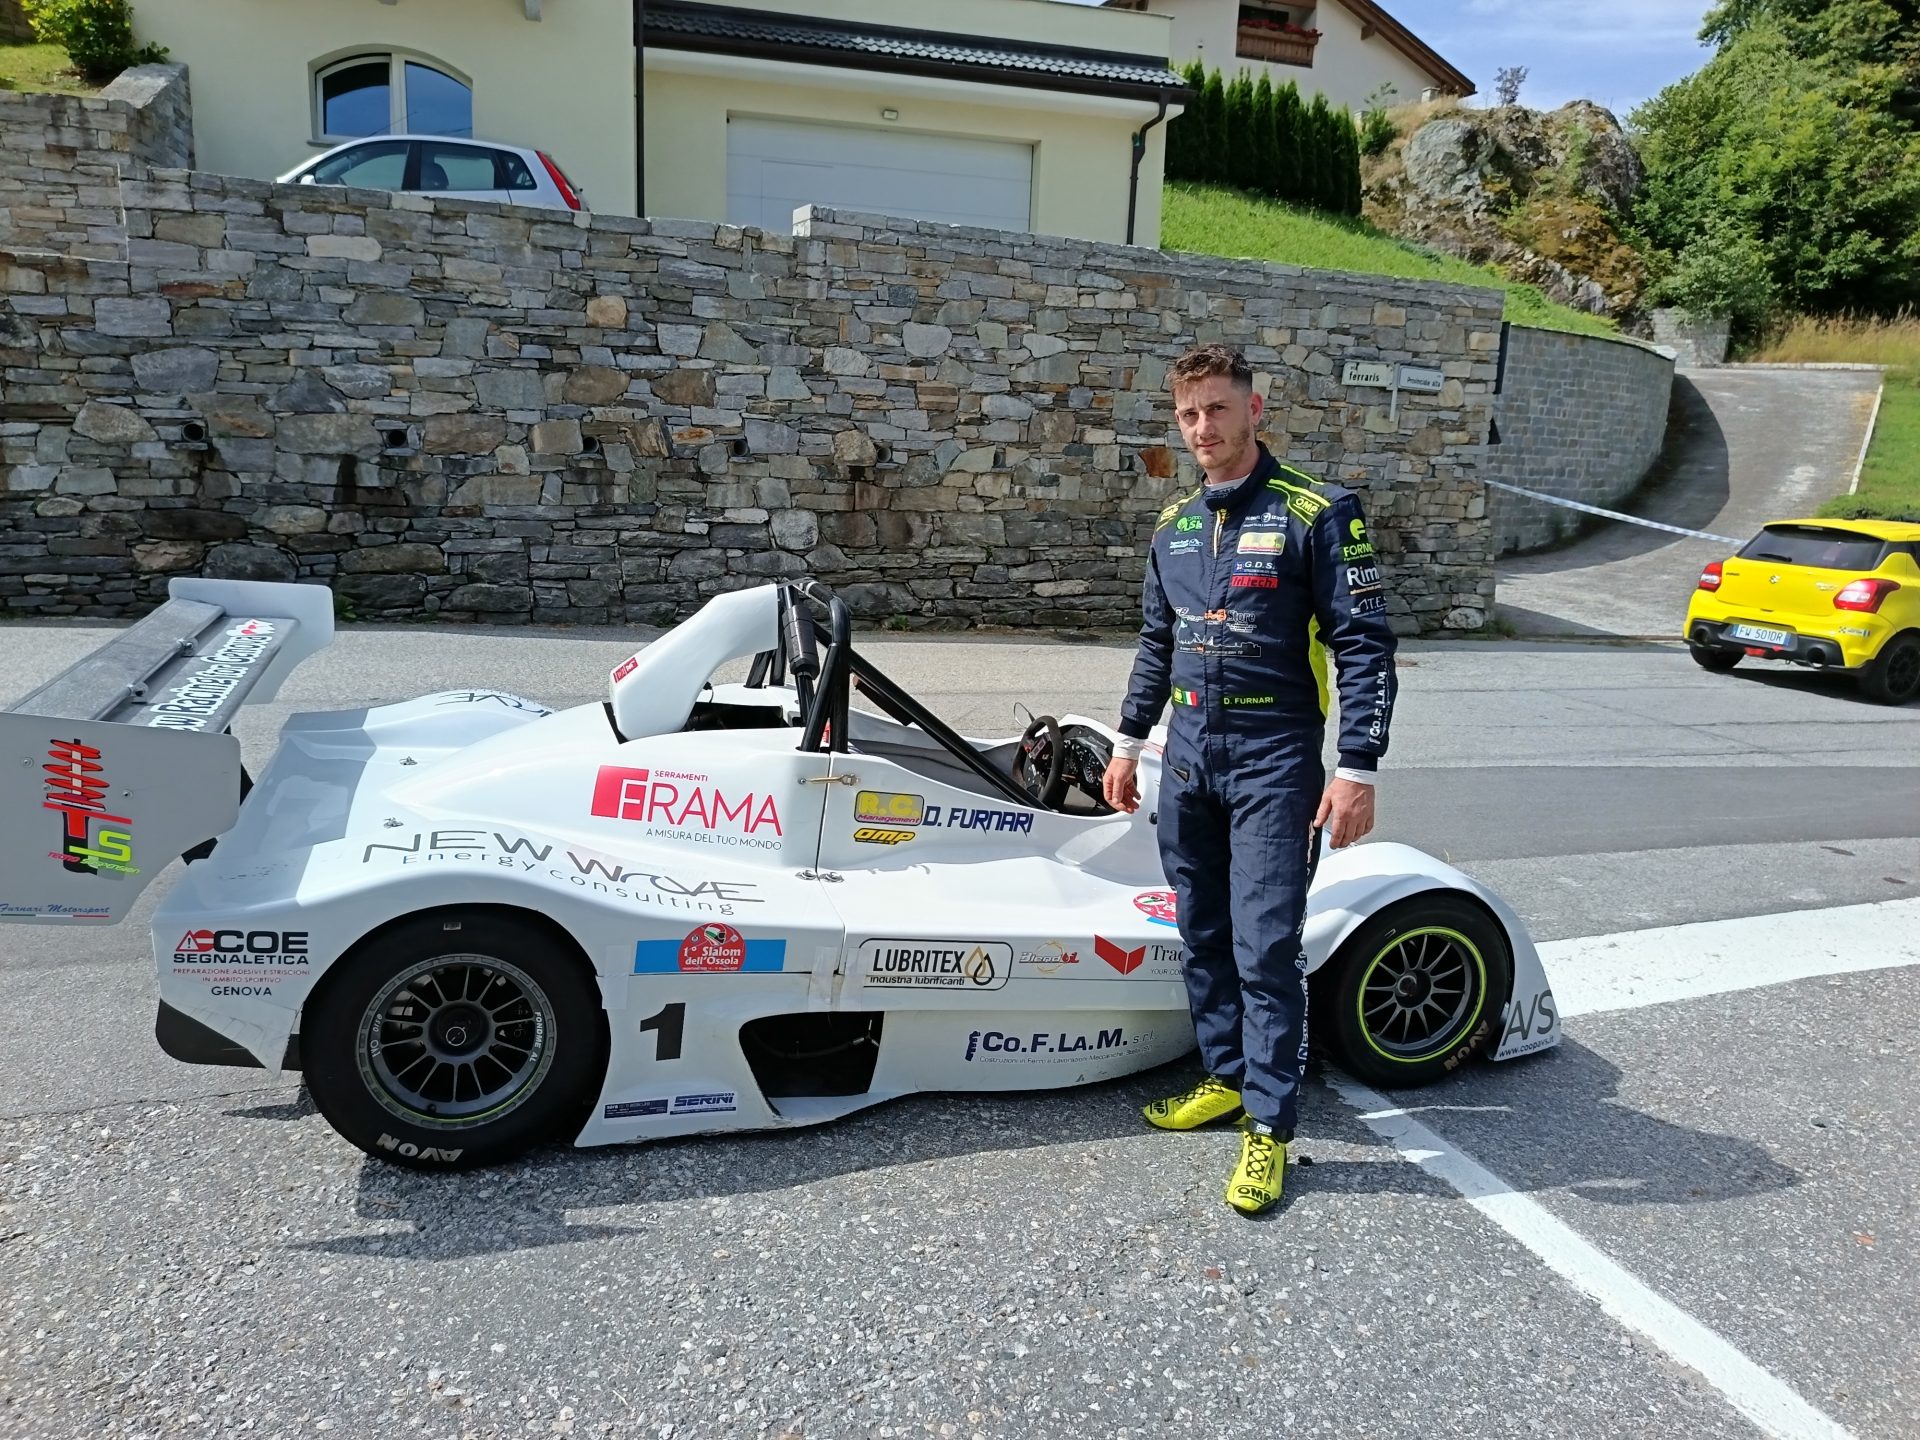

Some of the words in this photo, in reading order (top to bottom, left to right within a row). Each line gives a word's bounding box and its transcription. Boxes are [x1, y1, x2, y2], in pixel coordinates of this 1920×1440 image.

[1295, 497, 1318, 512] OMP
[1228, 610, 1256, 623] Store
[1738, 628, 1751, 637] FW
[203, 635, 273, 664] Genova
[198, 664, 246, 678] for
[152, 676, 238, 715] Racing
[1223, 697, 1233, 705] D.
[1234, 696, 1274, 704] FURNARI
[654, 770, 709, 782] SERRAMENTI
[617, 778, 783, 837] FRAMA
[859, 793, 920, 816] R.C.
[858, 815, 920, 824] Management
[922, 805, 942, 827] D.
[947, 808, 1034, 838] FURNARI
[646, 828, 653, 837] A
[655, 829, 692, 840] MISURA
[695, 833, 714, 844] DEL
[716, 835, 738, 846] TUO
[739, 839, 782, 850] MONDO
[855, 828, 915, 841] OMP
[362, 830, 552, 864] NEW
[402, 851, 537, 872] Energy
[549, 868, 735, 916] consulting
[0, 903, 42, 913] Furnari
[48, 904, 110, 914] Motorsport
[213, 930, 309, 954] COE
[702, 946, 741, 957] Slalom
[173, 953, 309, 965] SEGNALETICA
[685, 956, 739, 965] dell'Ossola
[872, 948, 966, 974] LUBRITEX
[870, 976, 912, 984] industria
[915, 976, 965, 986] lubrificanti
[211, 986, 272, 996] GENOVA
[640, 1002, 686, 1061] 1
[1443, 1018, 1490, 1071] AVON
[979, 1056, 1018, 1064] Costruzioni
[674, 1096, 734, 1107] SERINI
[1255, 1124, 1273, 1135] OMP
[376, 1132, 464, 1162] AVON
[1238, 1186, 1271, 1202] OMP
